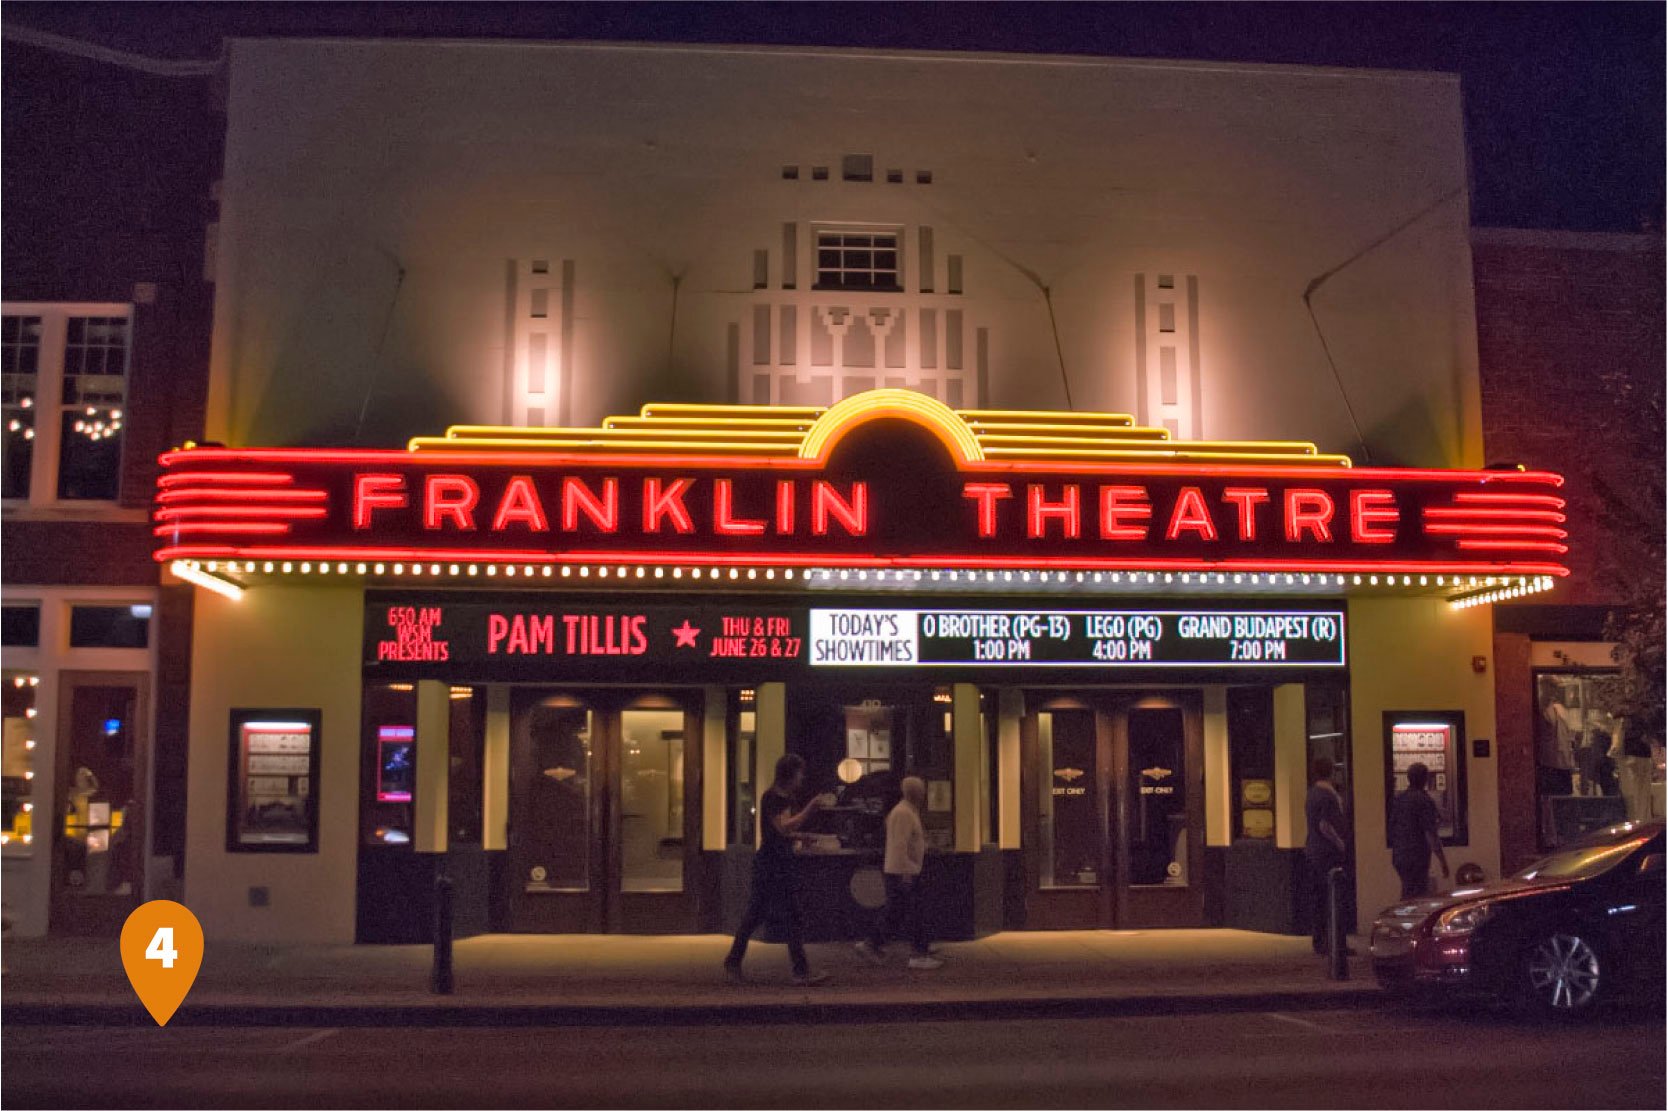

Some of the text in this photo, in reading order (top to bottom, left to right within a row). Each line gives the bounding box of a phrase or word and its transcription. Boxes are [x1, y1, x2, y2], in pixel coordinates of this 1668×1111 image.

[353, 474, 1399, 543] FRANKLIN THEATRE
[388, 607, 442, 626] 650 AM
[722, 617, 790, 636] THU & FRI
[829, 613, 898, 636] TODAY'S
[488, 614, 648, 655] PAM TILLIS
[924, 615, 1337, 641] O BROTHER (PG-13) LEGO (PG) GRAND BUDAPEST (R)
[378, 641, 449, 660] PRESENTS
[710, 637, 801, 657] JUNE 26 & 27
[816, 639, 912, 662] SHOWTIMES
[974, 640, 1031, 660] 1:00 PM
[1093, 640, 1152, 660] 4:00 PM
[1229, 640, 1286, 660] 7:00 PM
